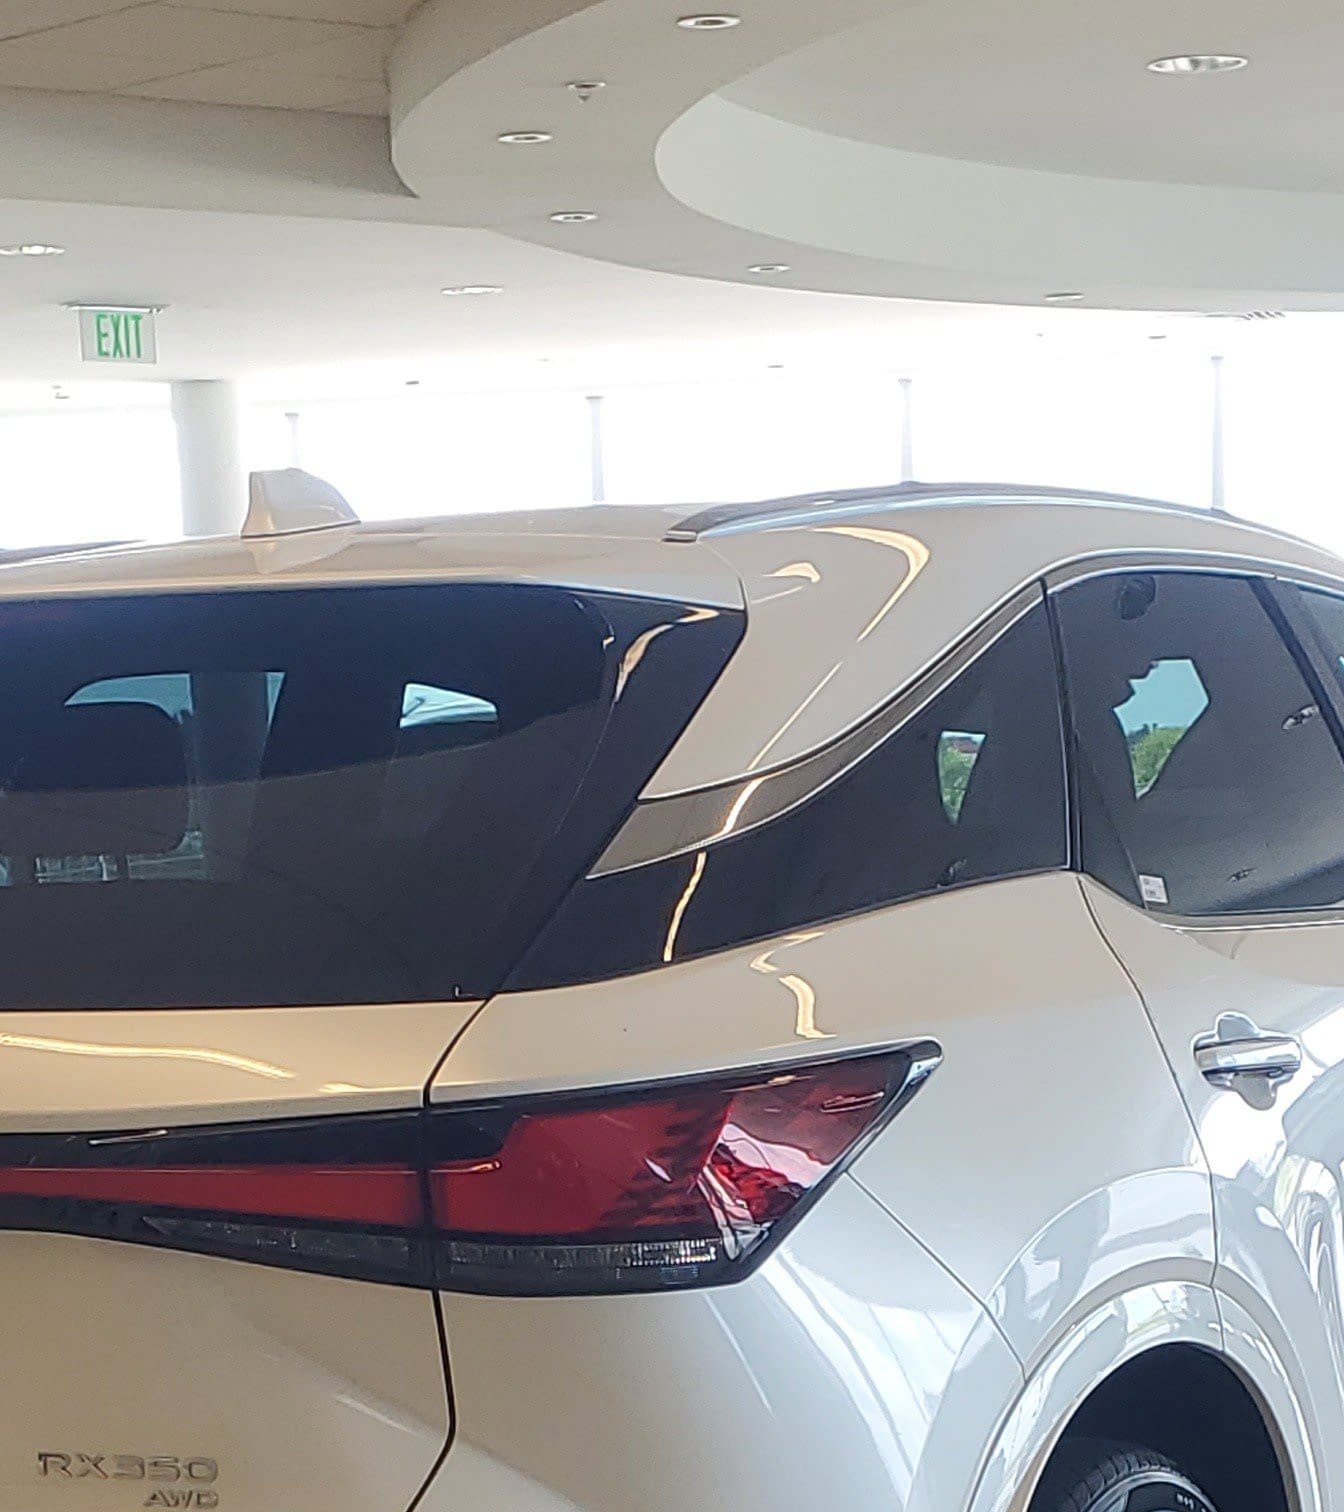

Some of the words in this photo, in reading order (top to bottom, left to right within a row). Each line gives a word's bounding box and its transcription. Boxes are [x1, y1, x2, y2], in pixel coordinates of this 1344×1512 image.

[96, 313, 143, 359] EXIT
[37, 1452, 219, 1484] RX350
[142, 1489, 219, 1509] AWD
